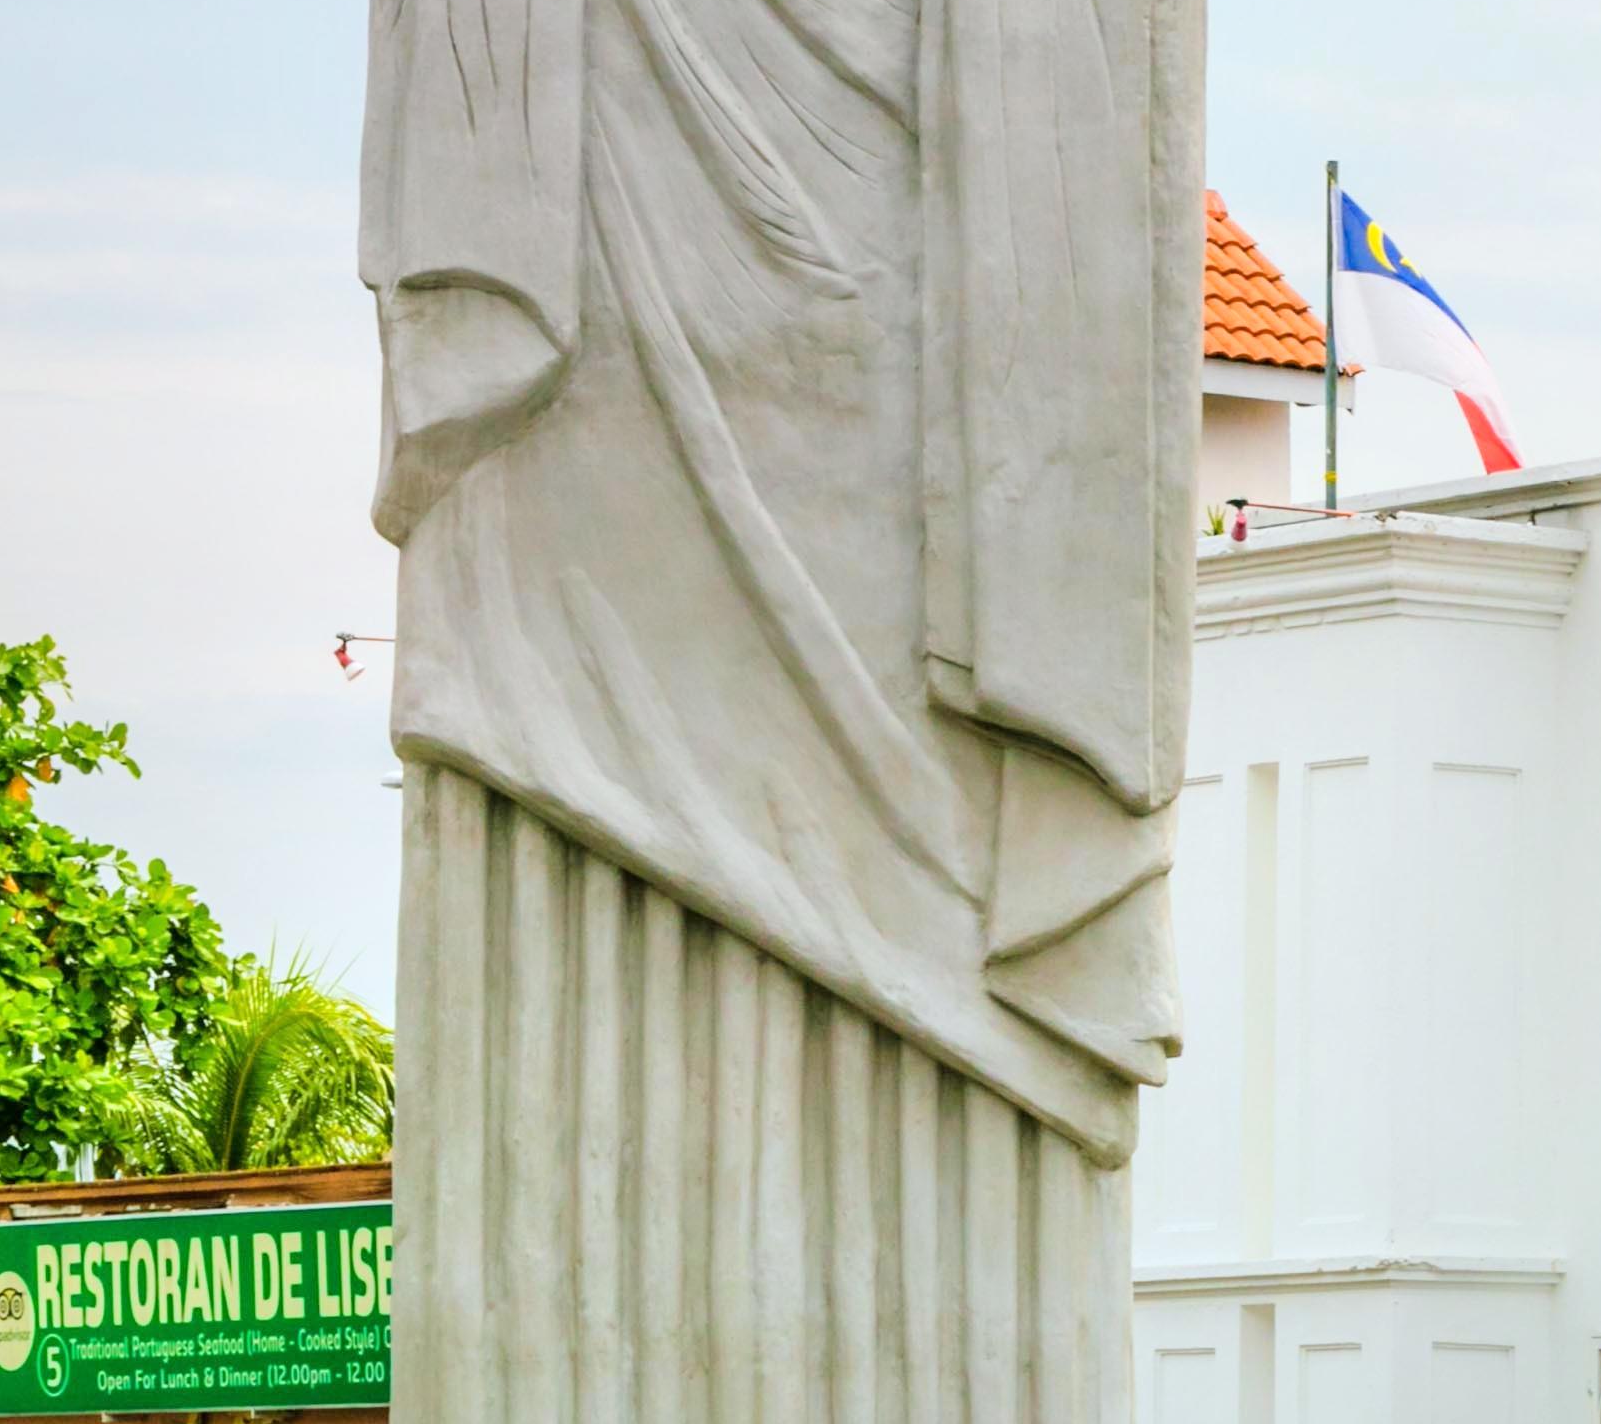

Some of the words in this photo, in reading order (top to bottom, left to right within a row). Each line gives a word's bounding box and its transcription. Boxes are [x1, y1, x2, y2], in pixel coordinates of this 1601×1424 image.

[37, 1236, 242, 1329] RESTORAN
[253, 1232, 306, 1320] DE
[69, 1336, 129, 1360] Traditional
[132, 1335, 195, 1363] Portuguese
[198, 1331, 244, 1356] Seafood
[247, 1329, 286, 1355] (Home
[298, 1327, 342, 1352] Cooked
[345, 1324, 380, 1355] Style)
[98, 1370, 131, 1395] Open
[135, 1369, 156, 1389] For
[160, 1367, 199, 1389] Lunch
[219, 1365, 263, 1388] Dinner
[267, 1363, 331, 1389] (12.00pm
[347, 1361, 385, 1383] 12.00
